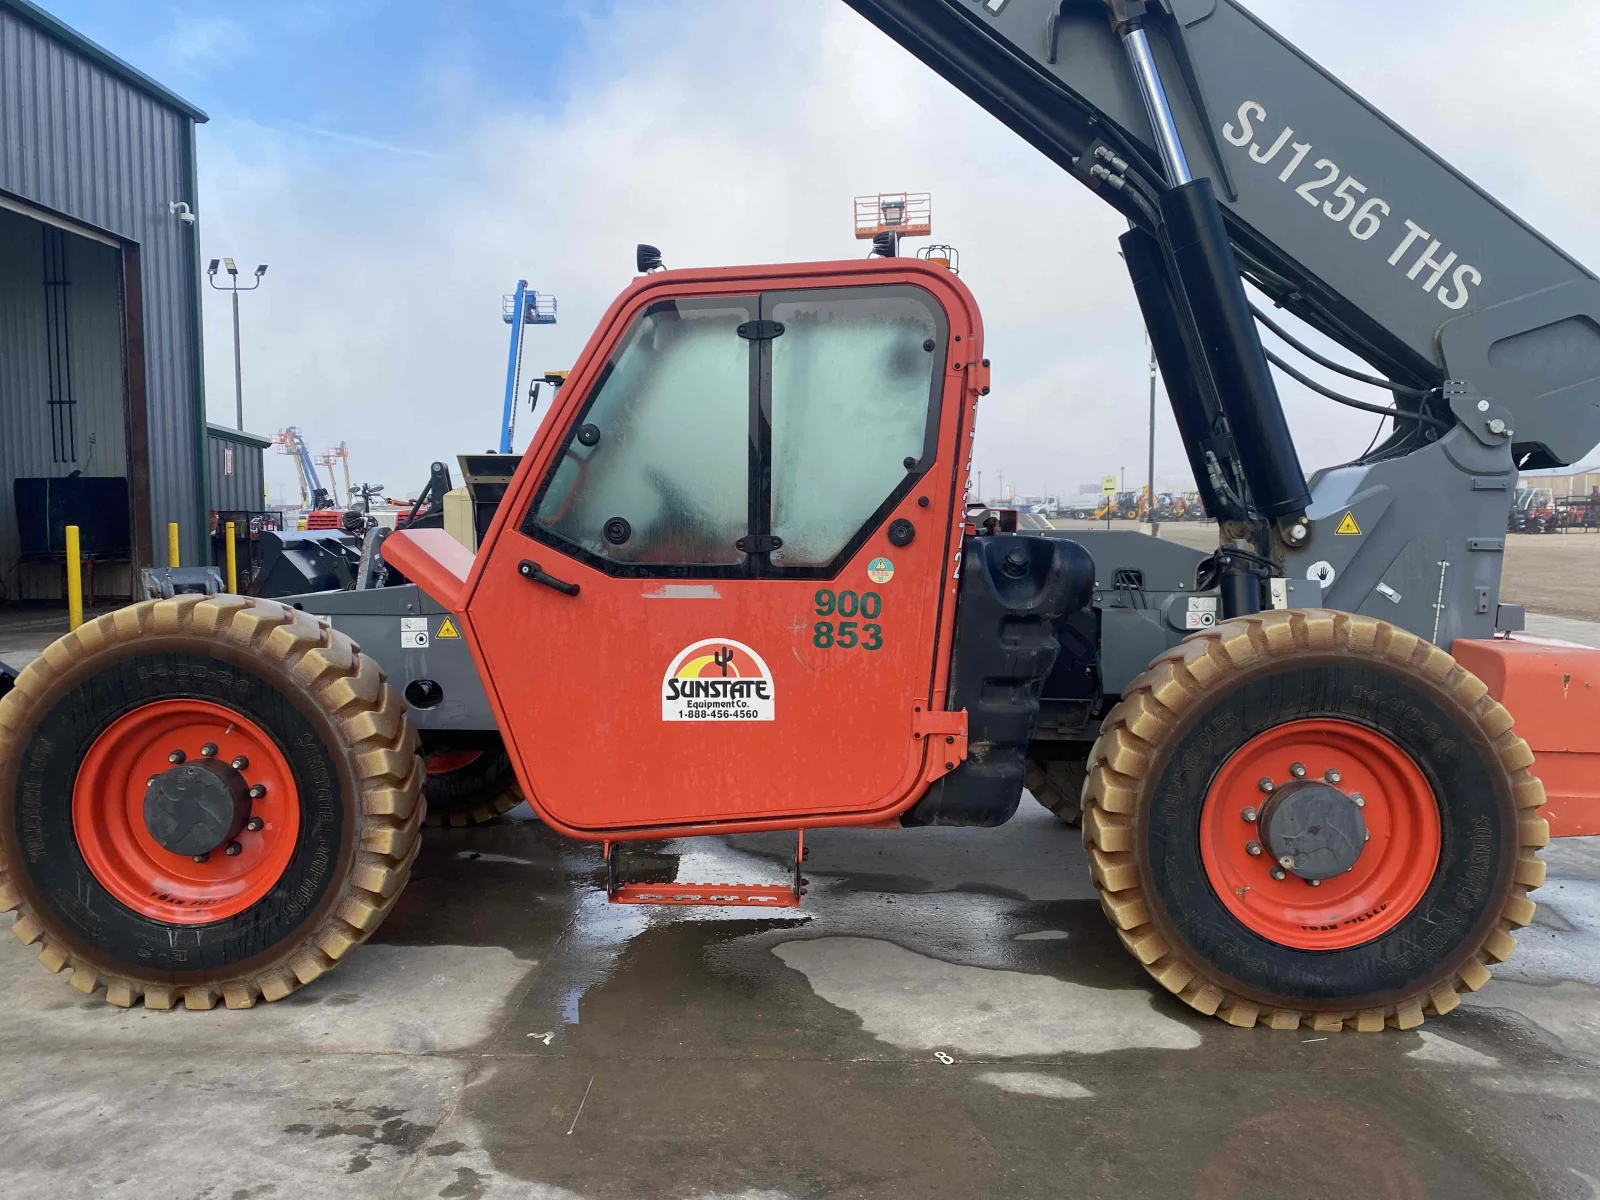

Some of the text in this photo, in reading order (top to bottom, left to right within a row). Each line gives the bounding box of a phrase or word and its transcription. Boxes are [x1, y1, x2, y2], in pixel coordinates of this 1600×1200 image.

[1222, 100, 1482, 310] SJ1256 THS
[814, 589, 882, 619] 900
[812, 621, 883, 651] 853
[666, 678, 771, 700] SUNSTATE
[678, 710, 758, 719] 1-888-456-4560
[687, 700, 749, 709] Equipment Co.
[934, 1051, 955, 1065] 8
